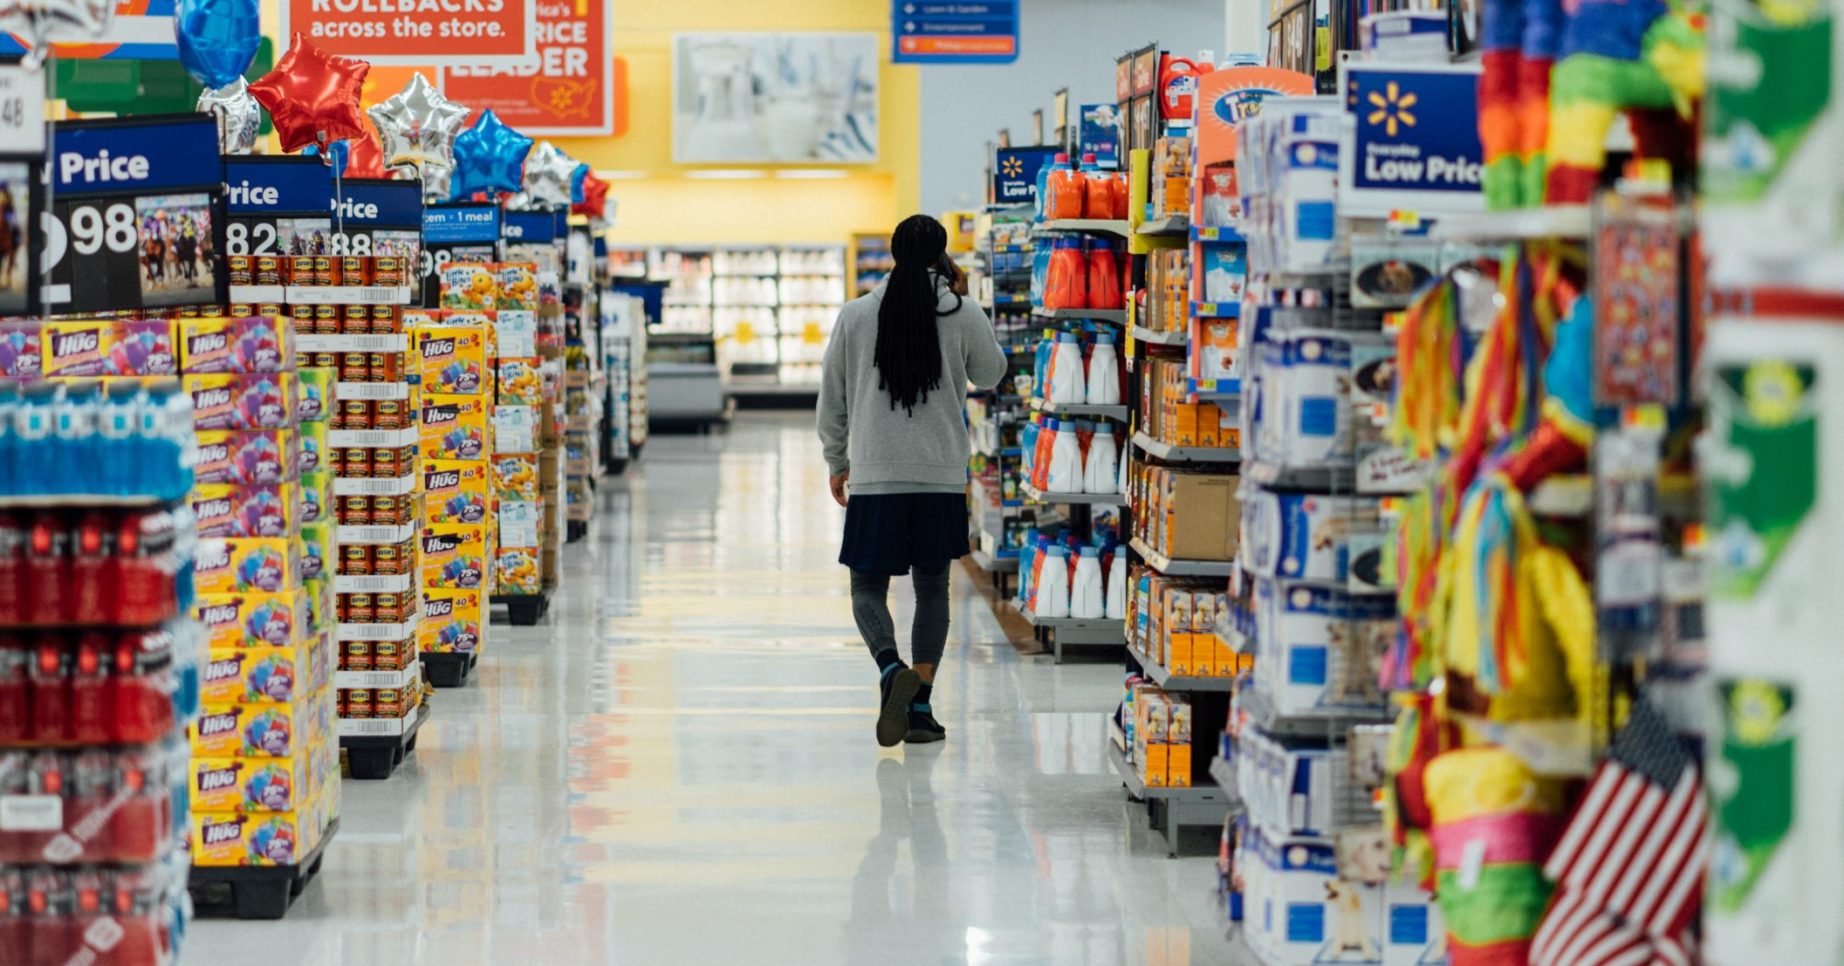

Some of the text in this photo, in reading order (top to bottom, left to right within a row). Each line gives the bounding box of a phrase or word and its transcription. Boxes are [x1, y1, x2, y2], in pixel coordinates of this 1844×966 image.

[311, 16, 505, 37] across the store.
[535, 22, 587, 43] RICE
[60, 149, 150, 182] Price
[1365, 155, 1423, 182] Low
[1426, 155, 1484, 183] Pric
[1004, 185, 1028, 196] Low
[465, 211, 493, 221] meal
[226, 223, 277, 256] 82
[501, 225, 523, 237] ice
[58, 333, 97, 357] HUG
[192, 334, 226, 355] HUG
[424, 341, 453, 357] HUG
[197, 388, 230, 410] HUG
[430, 473, 458, 489] HUG
[198, 500, 230, 520] HUG
[204, 605, 237, 626] HUG
[425, 602, 451, 617] HUG
[206, 660, 239, 681] HUG
[203, 715, 235, 735] HUG
[203, 770, 235, 791] HUG
[207, 824, 240, 845] HUG
